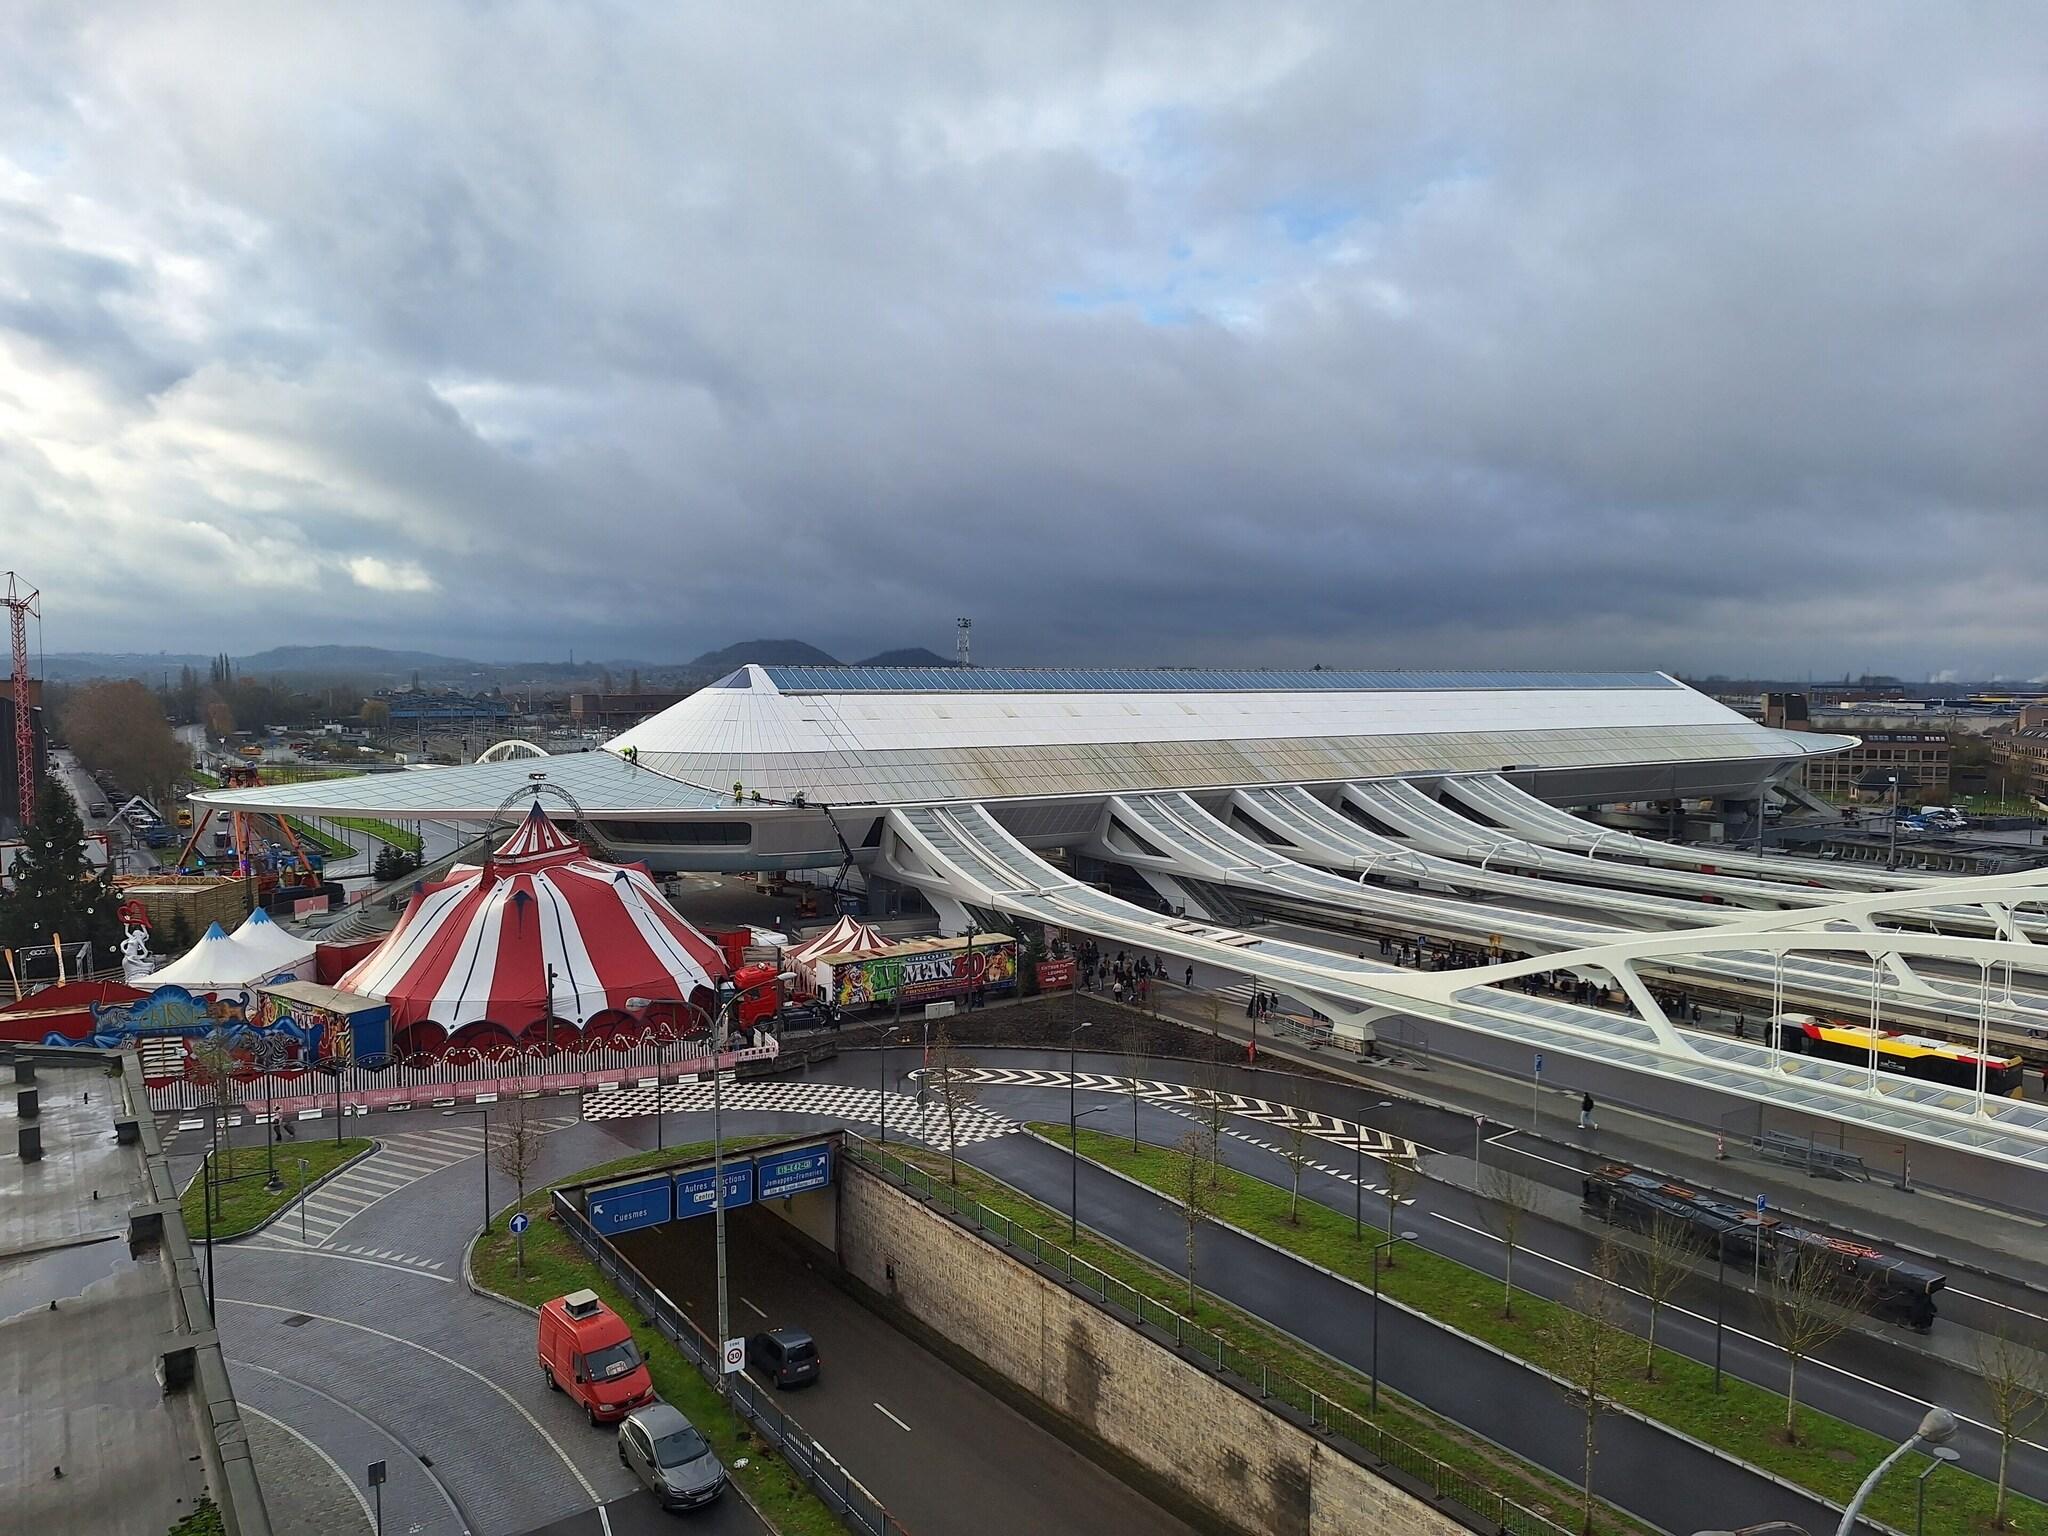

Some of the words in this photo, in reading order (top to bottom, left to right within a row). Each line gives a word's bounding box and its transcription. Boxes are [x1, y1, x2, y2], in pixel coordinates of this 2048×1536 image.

[685, 1182, 708, 1193] Autres
[711, 1174, 746, 1188] dctions
[695, 1191, 714, 1202] Centre
[614, 1208, 648, 1223] Cuesmes
[730, 1351, 740, 1361] 30
